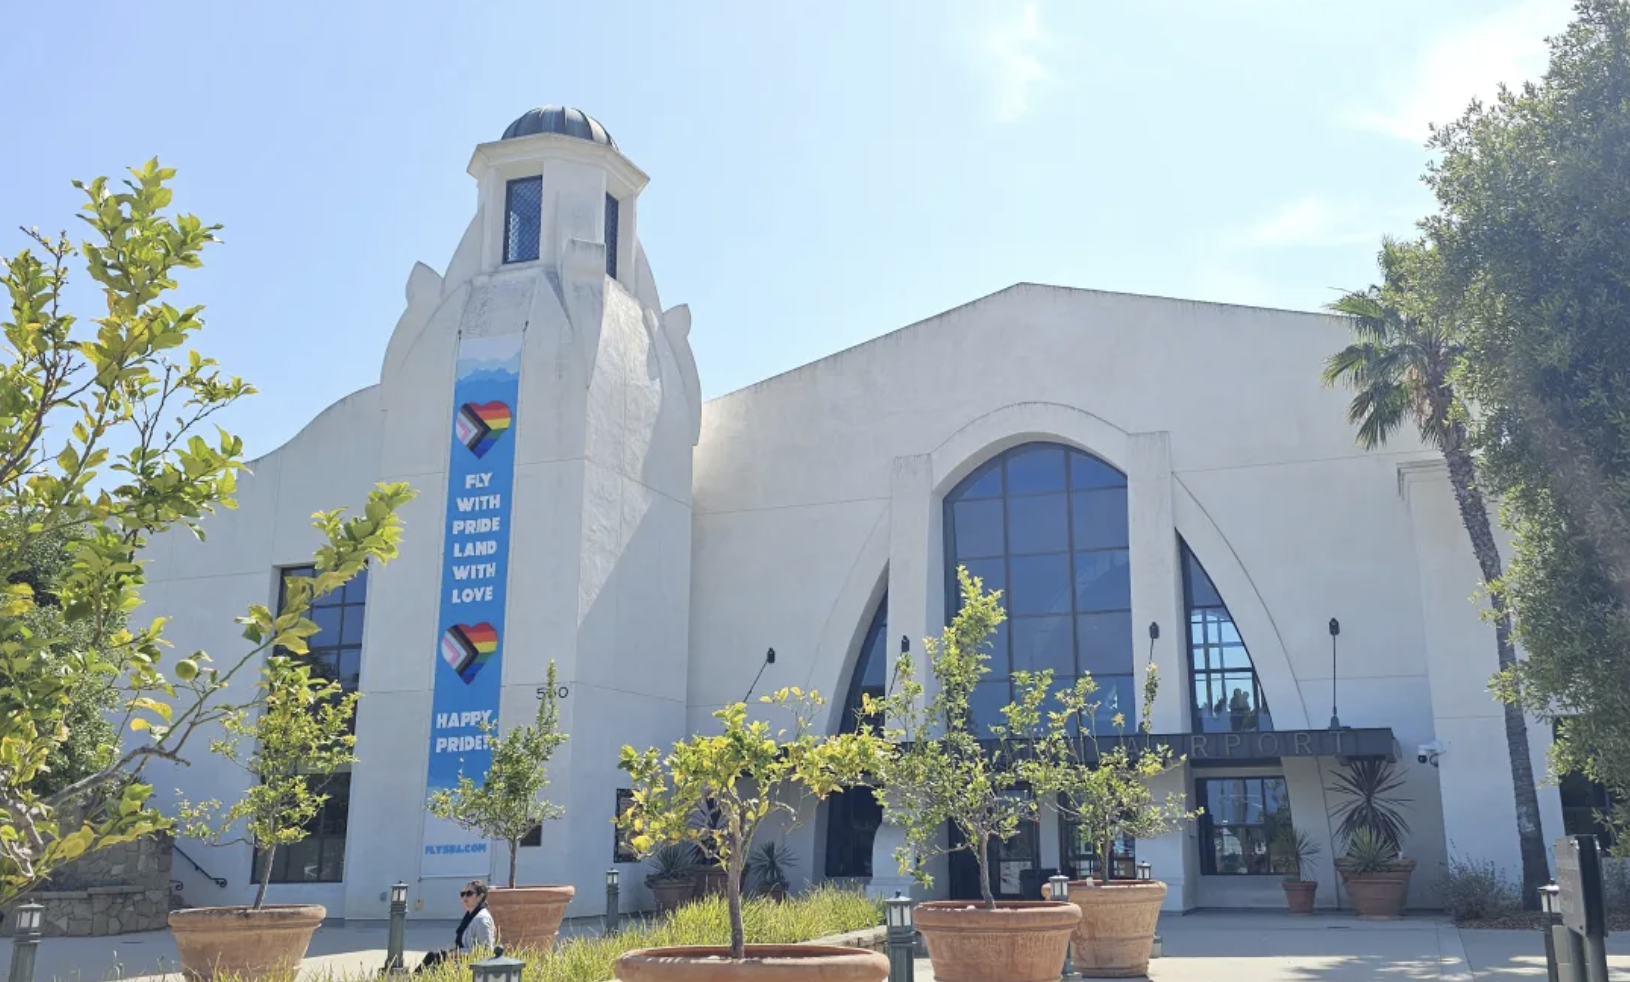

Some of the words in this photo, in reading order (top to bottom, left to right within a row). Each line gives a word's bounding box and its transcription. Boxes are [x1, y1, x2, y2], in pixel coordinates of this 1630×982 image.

[464, 472, 493, 489] FLY
[456, 494, 501, 512] WITH
[452, 517, 501, 535] PRIDE
[453, 540, 498, 558] LAND
[452, 562, 496, 580] WITH
[451, 585, 494, 604] LOVE
[535, 686, 570, 700] 50
[436, 709, 493, 729] HAPPY
[1126, 729, 1348, 759] ARPORT
